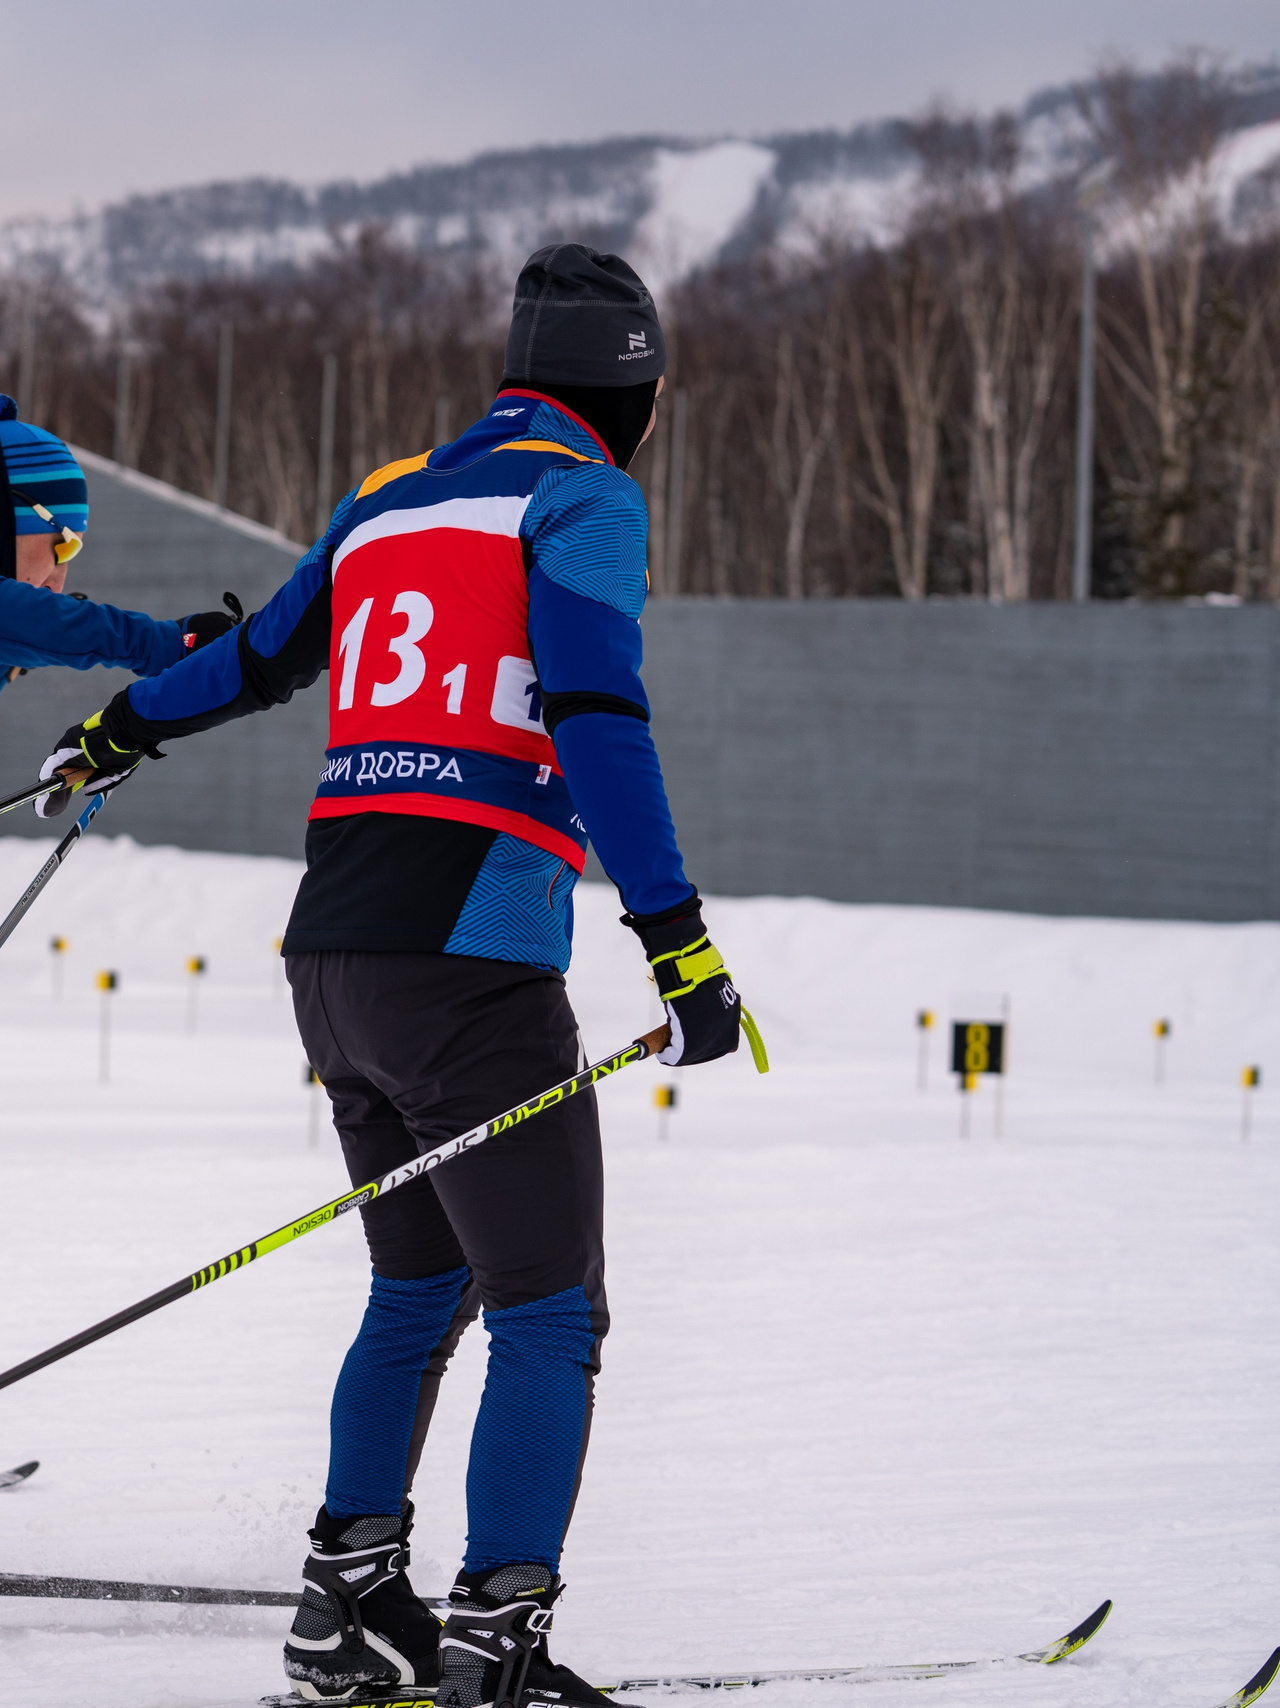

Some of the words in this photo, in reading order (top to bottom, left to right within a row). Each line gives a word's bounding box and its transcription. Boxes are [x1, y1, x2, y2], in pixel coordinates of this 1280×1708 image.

[618, 348, 655, 361] NORDSKI
[338, 590, 434, 711] 13
[441, 662, 468, 715] 1
[524, 679, 542, 723] 1
[356, 751, 464, 786] ДОБРА
[964, 1022, 990, 1073] 8
[337, 1190, 370, 1213] CARBON
[293, 1208, 331, 1236] DESIGN
